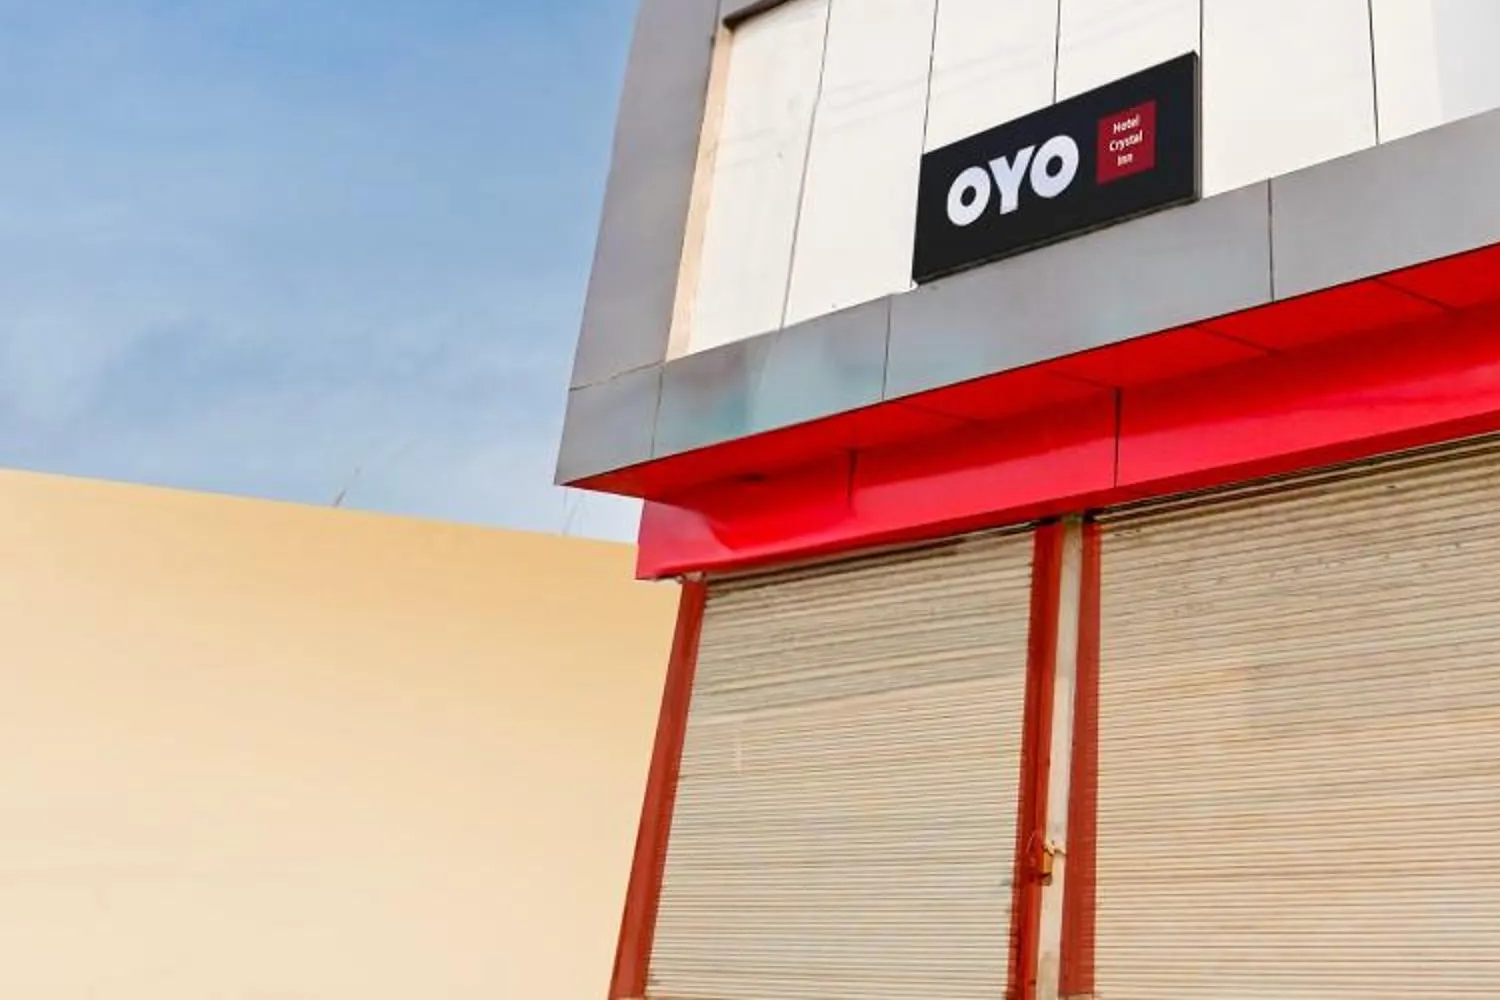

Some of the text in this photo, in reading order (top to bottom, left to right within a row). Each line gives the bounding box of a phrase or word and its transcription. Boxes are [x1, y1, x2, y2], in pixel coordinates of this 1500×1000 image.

[1112, 113, 1141, 135] Hotel
[1109, 128, 1143, 152] Crystal
[1117, 153, 1134, 167] Inn
[947, 134, 1080, 227] OYO
